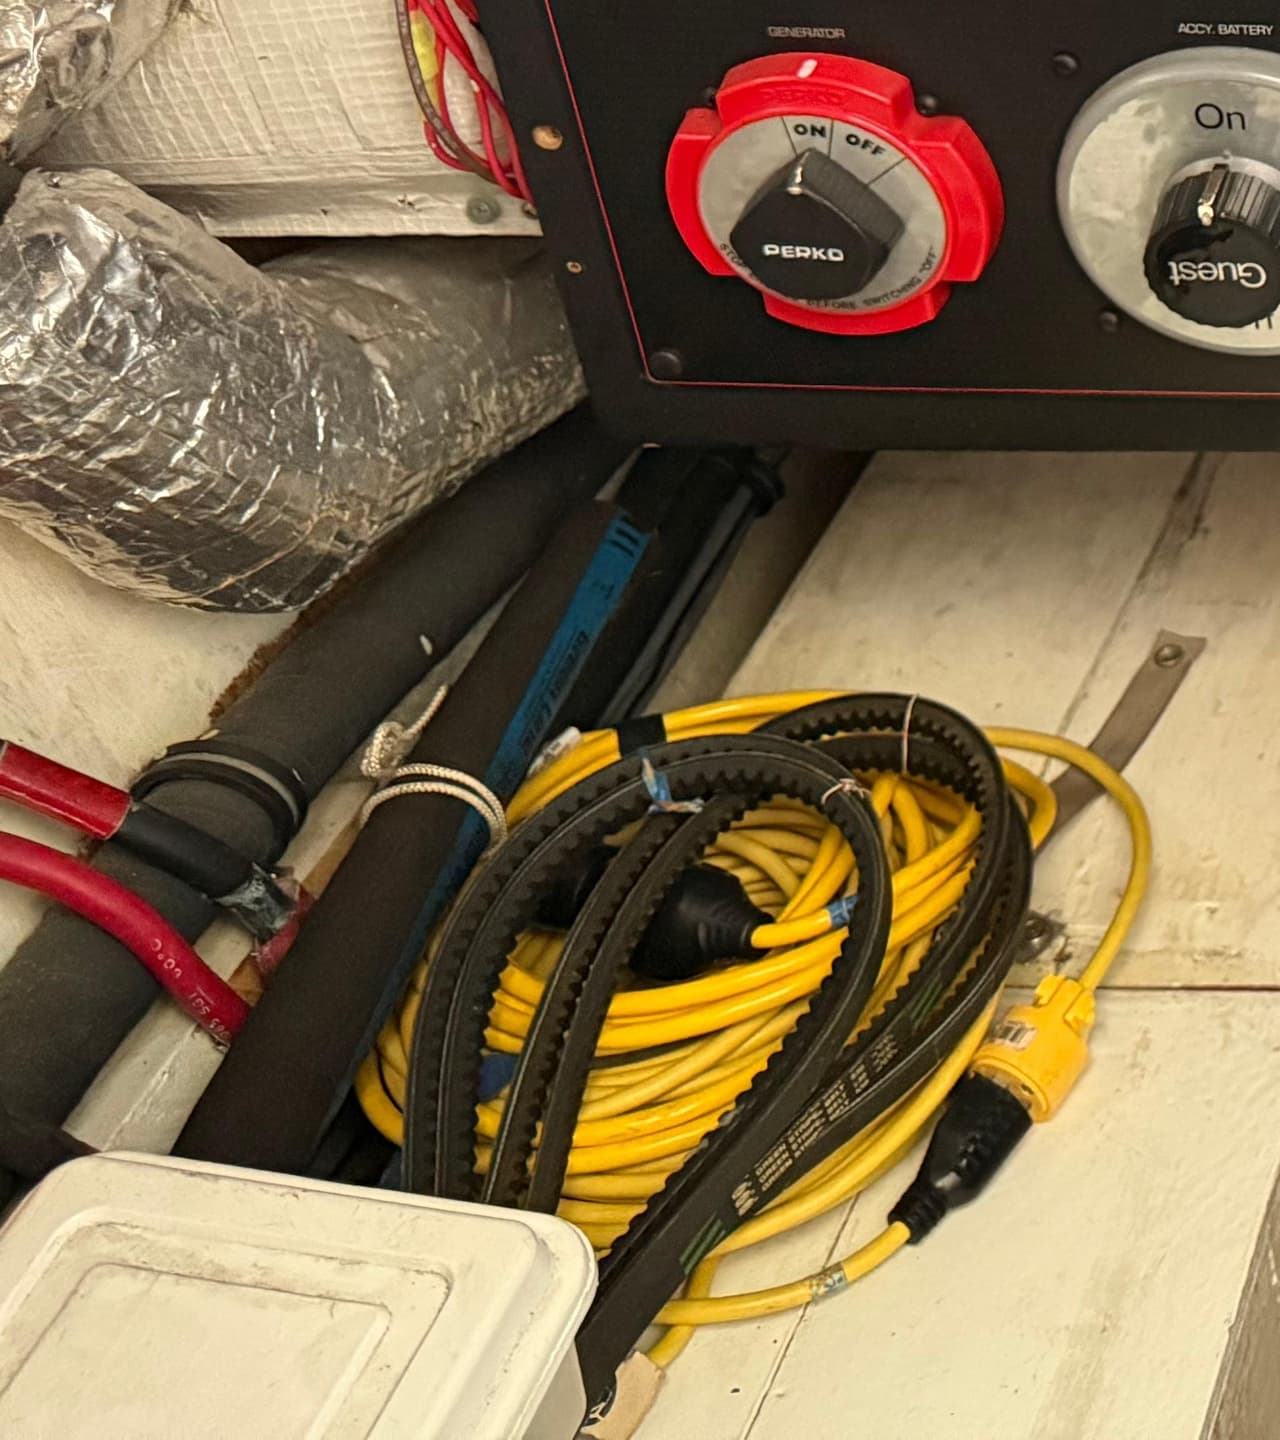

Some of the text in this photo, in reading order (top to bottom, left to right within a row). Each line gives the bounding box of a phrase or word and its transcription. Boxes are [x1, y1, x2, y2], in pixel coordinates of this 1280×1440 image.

[768, 26, 846, 40] GENERATOR
[1218, 23, 1274, 37] BATTERY
[1195, 103, 1247, 131] On
[794, 124, 828, 139] ON
[845, 133, 886, 157] OFF
[763, 244, 845, 262] PERKO
[1169, 260, 1267, 289] Guest
